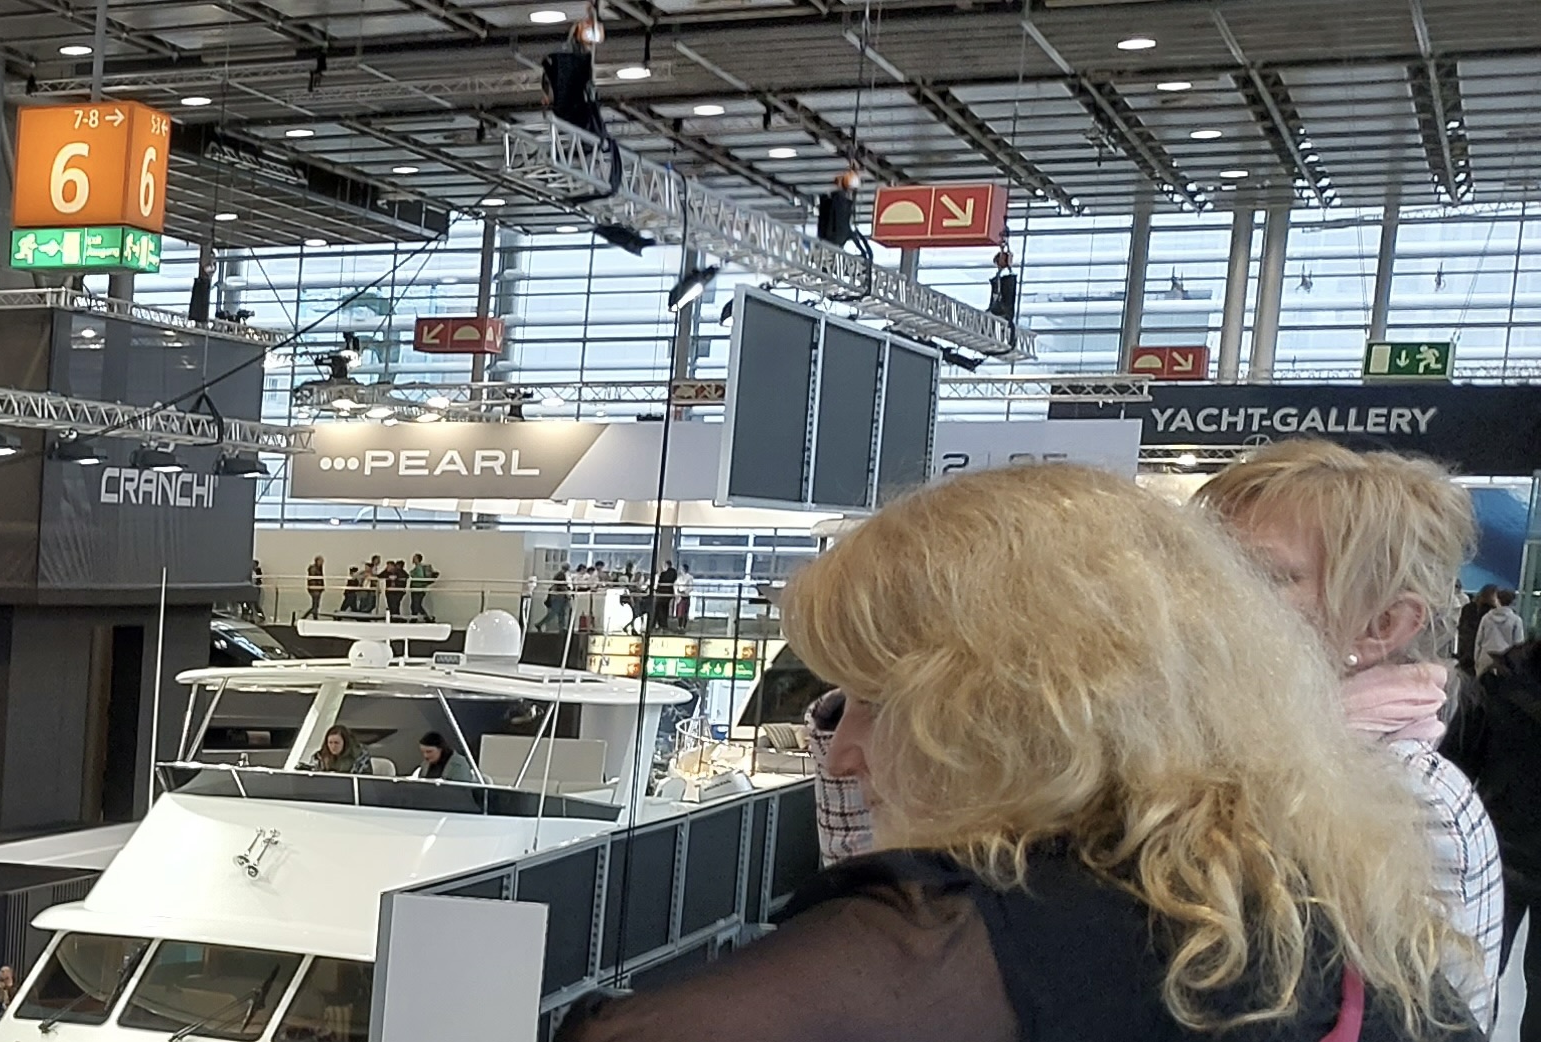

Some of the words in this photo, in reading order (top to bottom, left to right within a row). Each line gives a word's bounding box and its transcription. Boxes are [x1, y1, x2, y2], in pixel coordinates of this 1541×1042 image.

[73, 109, 99, 129] 7-8
[50, 142, 90, 214] 6
[139, 146, 157, 217] 6
[1151, 407, 1438, 436] YACHT-GALLERY
[364, 449, 541, 477] PEARL
[100, 468, 214, 509] CRANCHI
